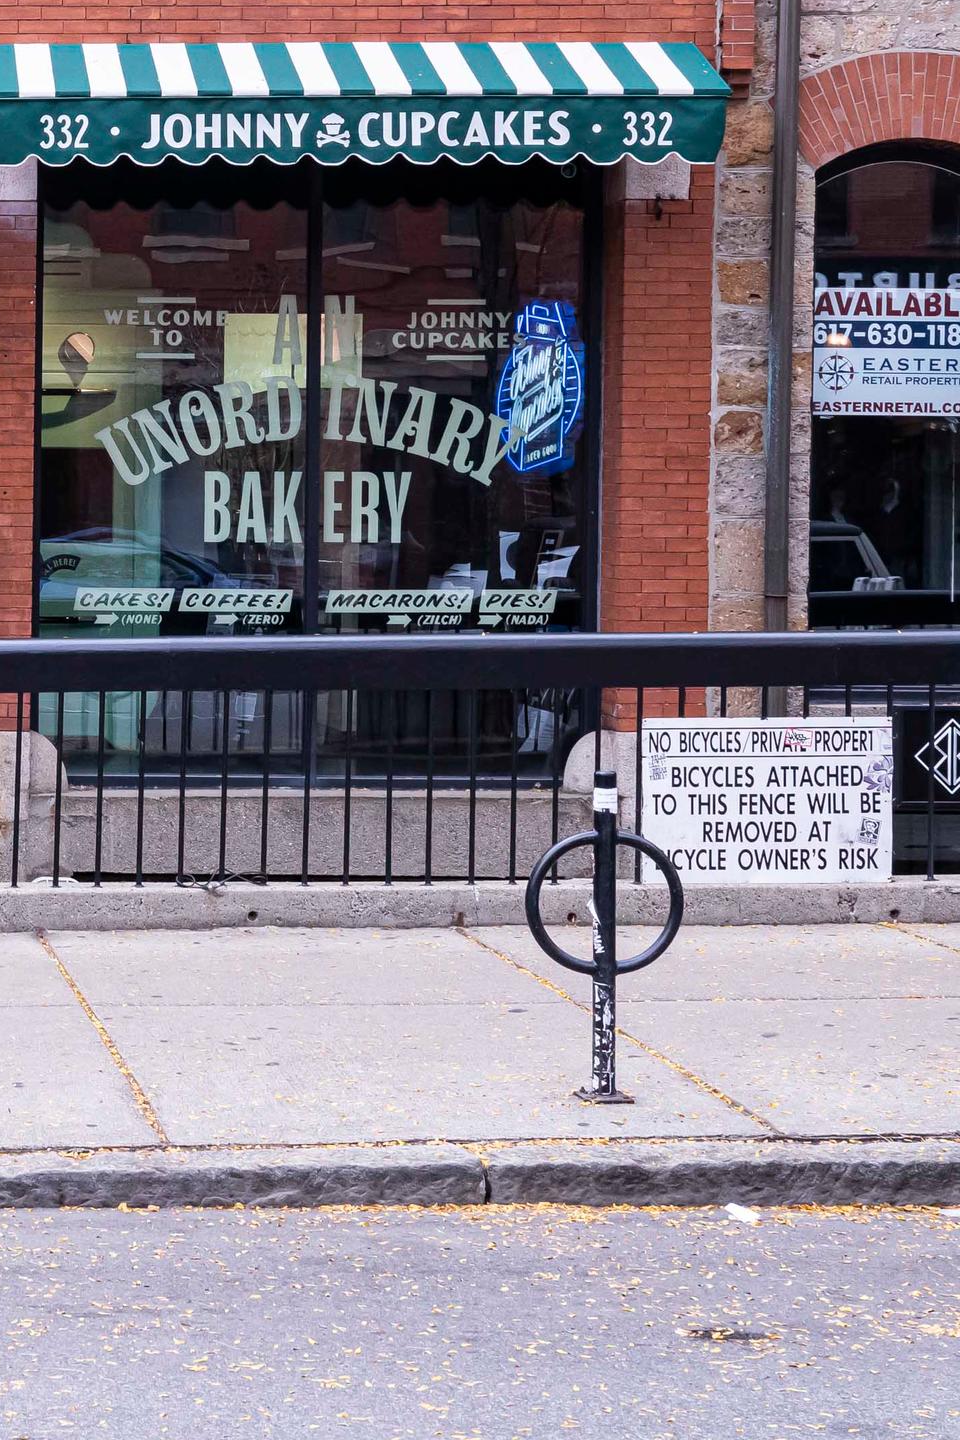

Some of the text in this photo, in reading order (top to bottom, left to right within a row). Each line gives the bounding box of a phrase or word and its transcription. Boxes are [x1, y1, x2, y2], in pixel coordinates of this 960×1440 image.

[40, 110, 673, 149] 332 JOHNNY CUPCAKES 332
[815, 292, 960, 317] AVAILABL
[103, 309, 230, 327] WELCOME
[406, 311, 513, 329] JOHNNY
[149, 328, 183, 346] TO
[391, 332, 527, 350] CUPCAKES
[814, 323, 960, 346] 617-630-118
[863, 357, 959, 372] EASTER
[862, 376, 902, 385] RETAIL
[812, 402, 960, 413] EASTERNRETAIL.CO
[203, 471, 412, 544] BAKERY
[79, 591, 170, 608] CAKES!
[185, 592, 288, 609] COFFEE!
[331, 592, 469, 609] MACARONS!
[485, 592, 553, 609] PIES!
[121, 613, 163, 626] (NONE)
[242, 614, 284, 626] (ZERO)
[416, 613, 462, 626] (ZILCH)
[505, 613, 549, 626] (NADA)
[648, 732, 671, 753] NO
[671, 766, 754, 788] BICYCLES
[766, 765, 863, 787] ATTACHED
[652, 792, 881, 815] TO THIS FENCE WILL BE
[703, 821, 831, 843] REMOVED AT
[656, 847, 879, 871] ICYCLE OWNER'S RISK
